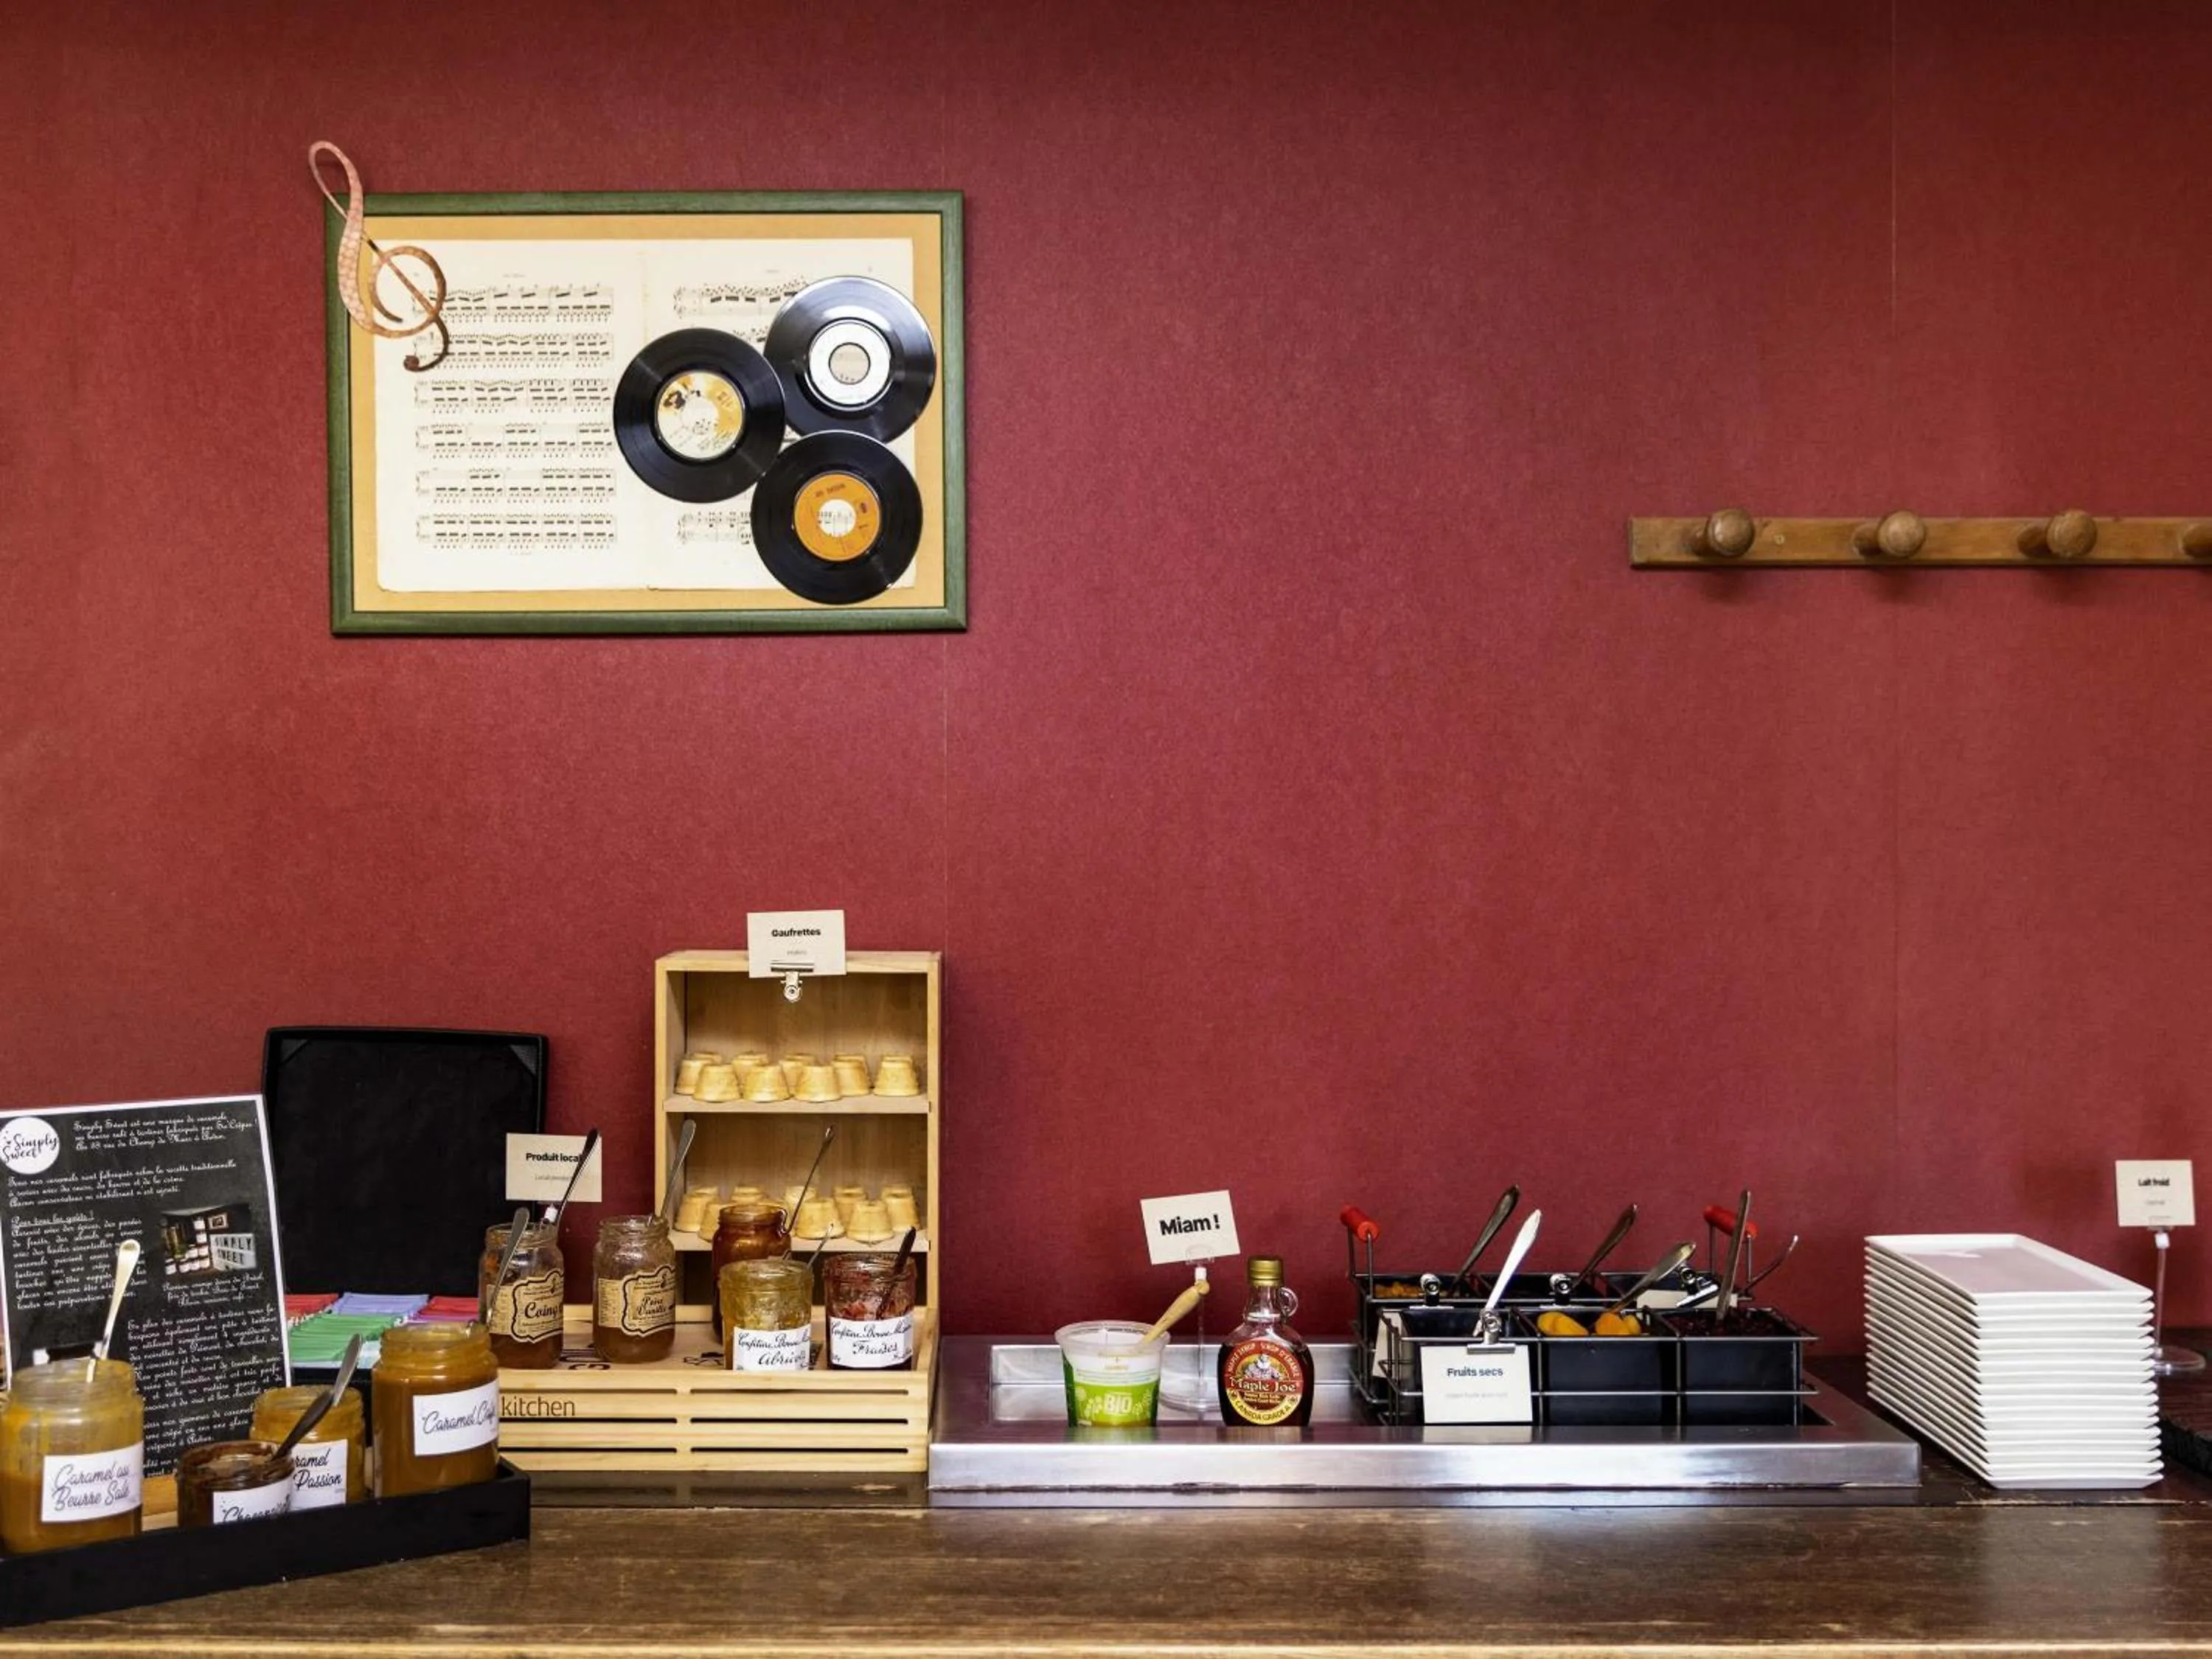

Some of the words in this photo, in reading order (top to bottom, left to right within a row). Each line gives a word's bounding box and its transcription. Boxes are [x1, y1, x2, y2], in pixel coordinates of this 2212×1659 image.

[771, 928, 821, 937] Gaufrettes
[2, 1144, 38, 1164] Sweet
[13, 1133, 57, 1154] Simply
[526, 1152, 558, 1162] Produit
[1159, 1215, 1211, 1236] Miam
[524, 1301, 558, 1319] Coing
[852, 1340, 898, 1355] Fraises
[1447, 1366, 1477, 1377] Fruits
[1478, 1368, 1504, 1377] secs
[1229, 1376, 1270, 1392] Maple
[1274, 1380, 1296, 1392] Joe
[502, 1395, 576, 1416] kitchen
[1104, 1392, 1133, 1416] BIO
[1235, 1400, 1262, 1420] CANADA
[422, 1405, 477, 1434] Caramel
[294, 1447, 331, 1468] ramel
[55, 1460, 116, 1489] Caramel
[116, 1465, 131, 1478] au
[293, 1468, 343, 1492] Passion
[51, 1486, 102, 1512] Beurre
[104, 1480, 131, 1506] Salé
